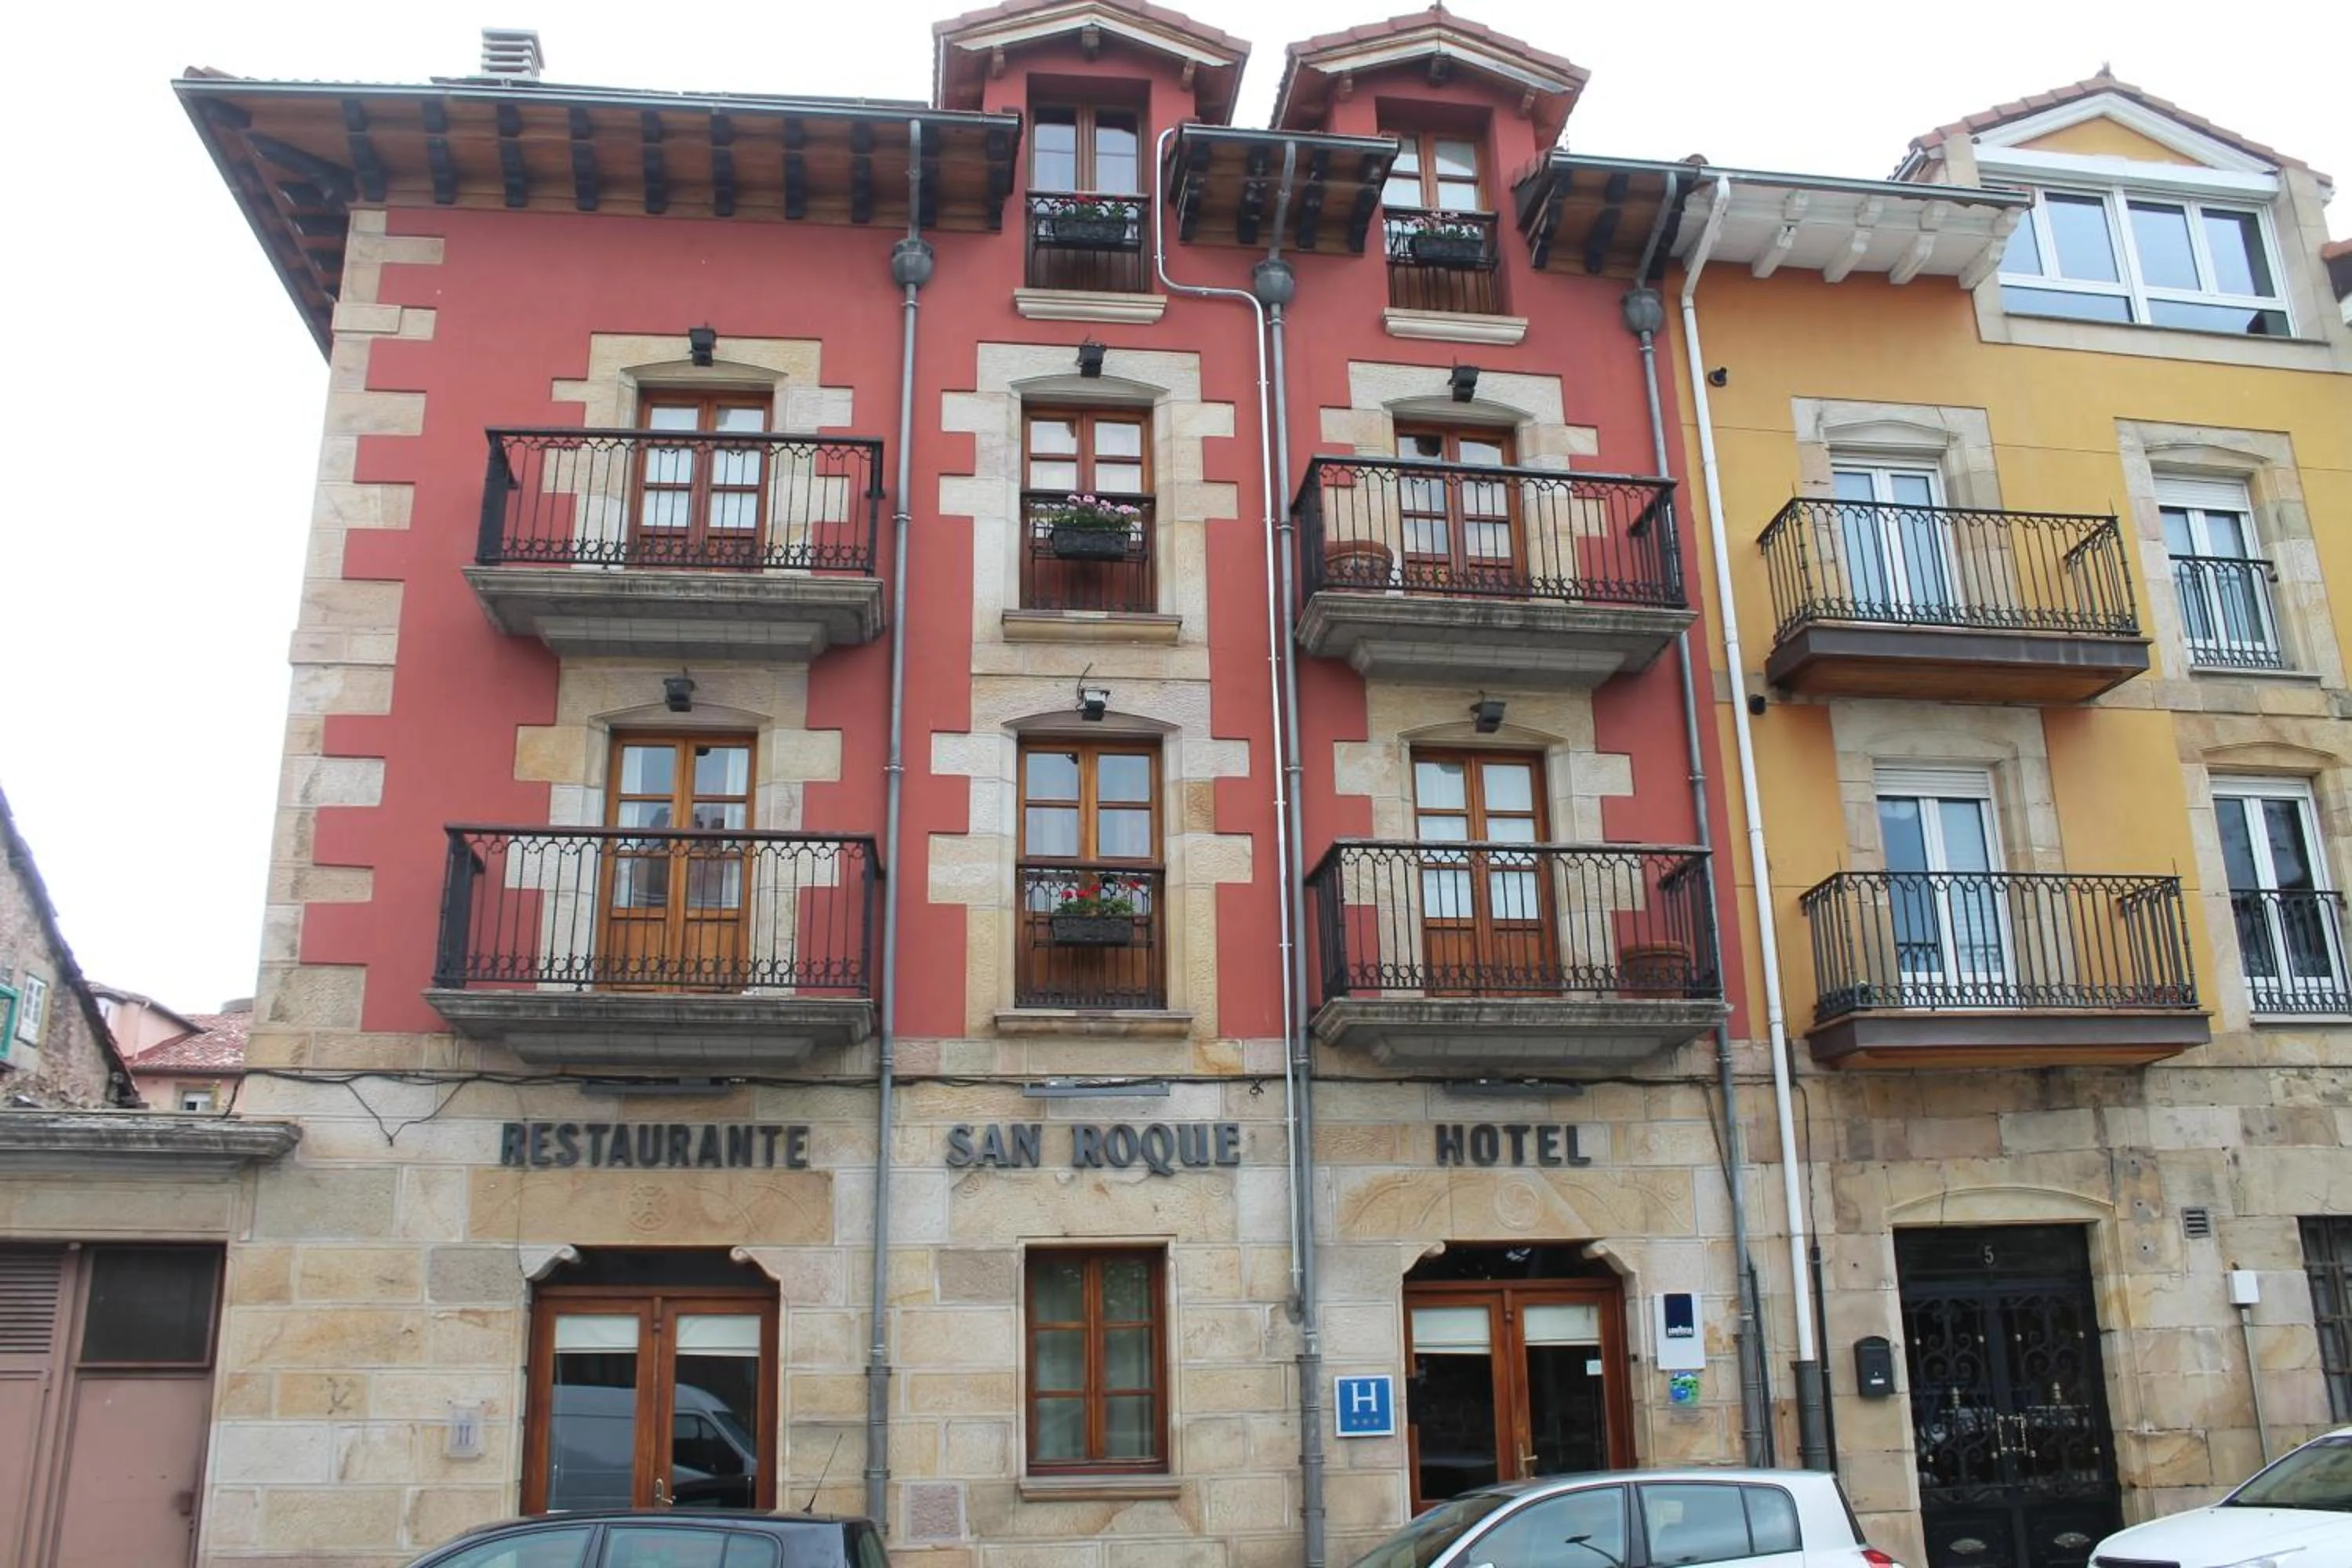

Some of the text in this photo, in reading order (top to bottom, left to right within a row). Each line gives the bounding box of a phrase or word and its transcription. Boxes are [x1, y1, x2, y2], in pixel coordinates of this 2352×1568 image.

[501, 1122, 810, 1169] RESTAURANTE
[946, 1122, 1241, 1176] SAN ROQUE
[1435, 1123, 1592, 1167] HOTEL
[1984, 1245, 1994, 1264] 5
[1351, 1381, 1378, 1413] H
